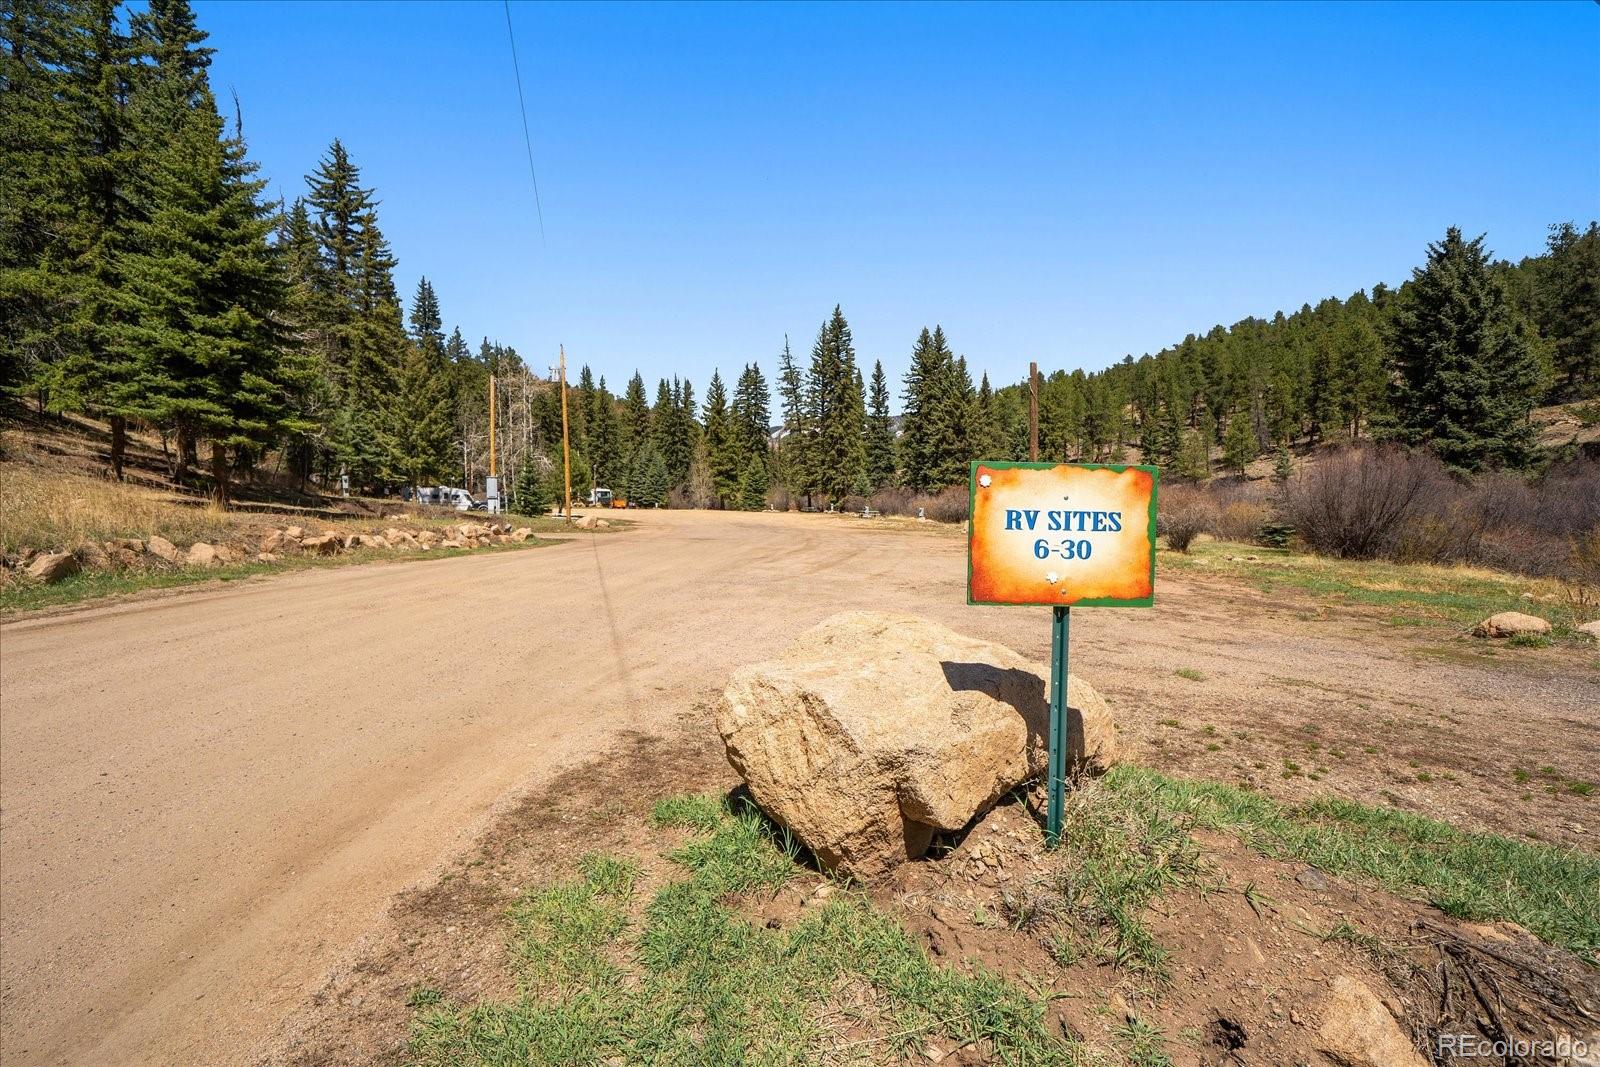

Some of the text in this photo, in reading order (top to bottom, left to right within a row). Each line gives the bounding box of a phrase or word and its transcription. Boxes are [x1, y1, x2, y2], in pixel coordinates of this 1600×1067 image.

[1005, 510, 1122, 532] RV SITES
[1034, 539, 1092, 560] 6-30
